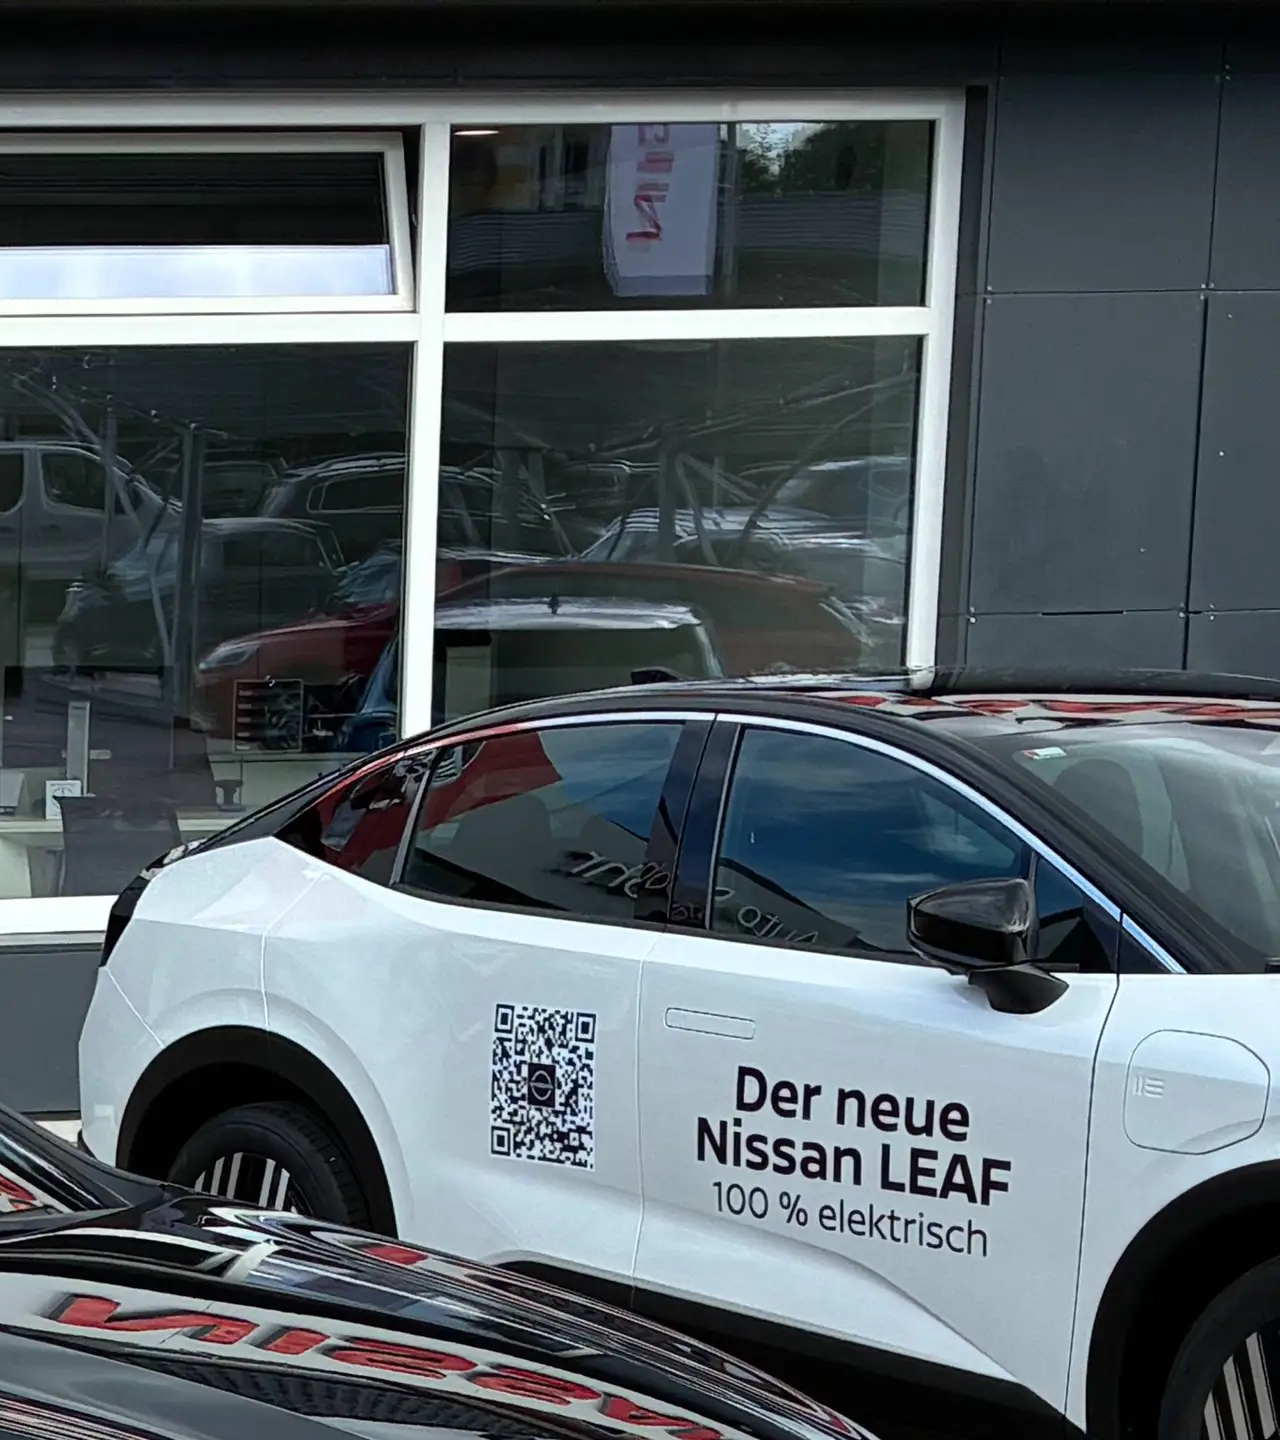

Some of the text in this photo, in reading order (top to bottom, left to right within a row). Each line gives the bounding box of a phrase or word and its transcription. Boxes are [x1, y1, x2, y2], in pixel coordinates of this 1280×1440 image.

[735, 1065, 971, 1143] Der neue
[696, 1117, 1012, 1207] Nissan LEAF
[712, 1180, 988, 1258] 100 % elektrisch
